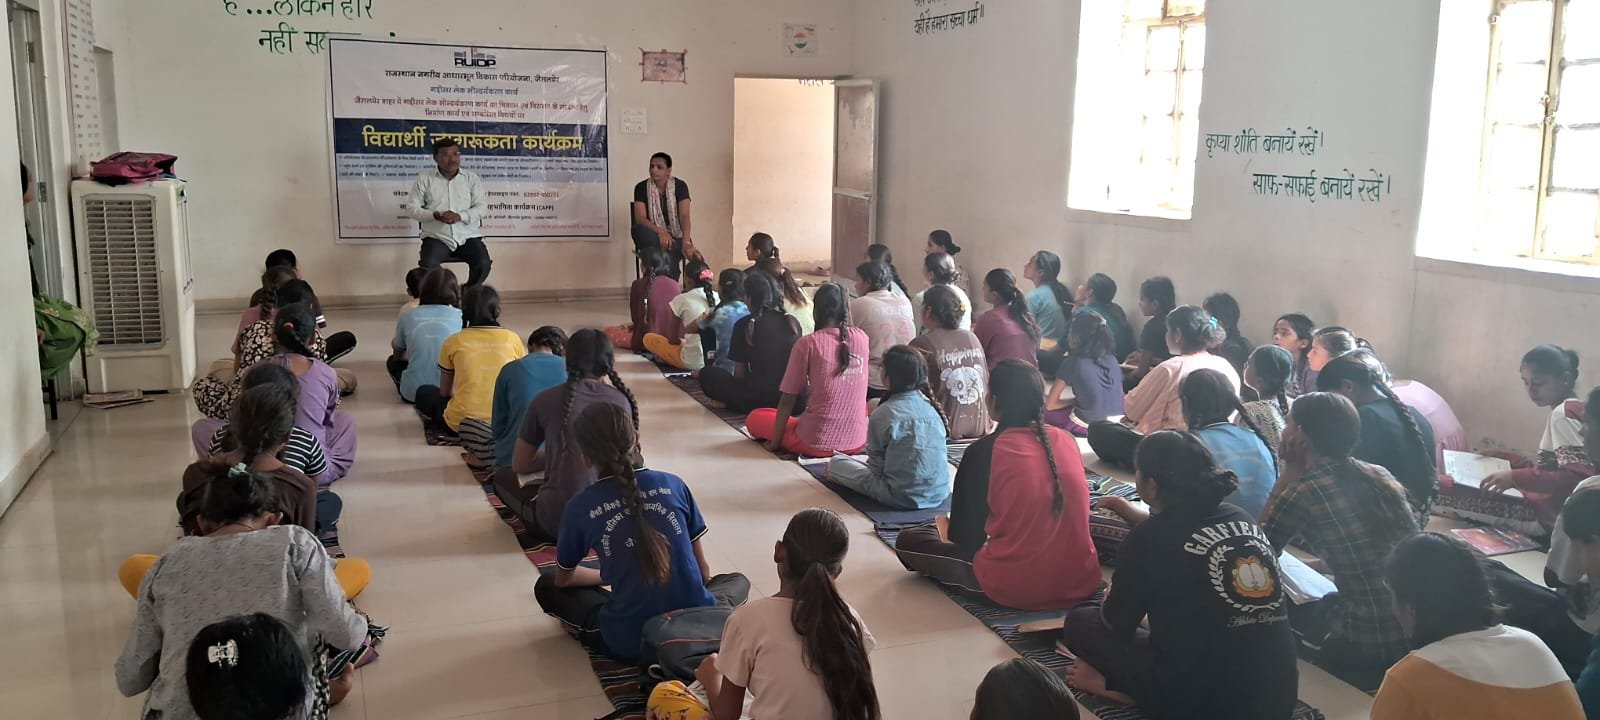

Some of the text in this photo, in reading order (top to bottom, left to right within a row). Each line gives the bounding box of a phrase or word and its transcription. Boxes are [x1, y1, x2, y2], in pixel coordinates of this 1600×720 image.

[258, 22, 298, 55] नहीं
[454, 53, 496, 68] RUIDP
[385, 70, 416, 78] राजस्थान
[418, 70, 440, 79] नगरीय
[442, 72, 473, 82] आधारभूत
[476, 72, 498, 81] विकास
[362, 124, 584, 151] विद्यार्थी गरूकता कार्यक्रम
